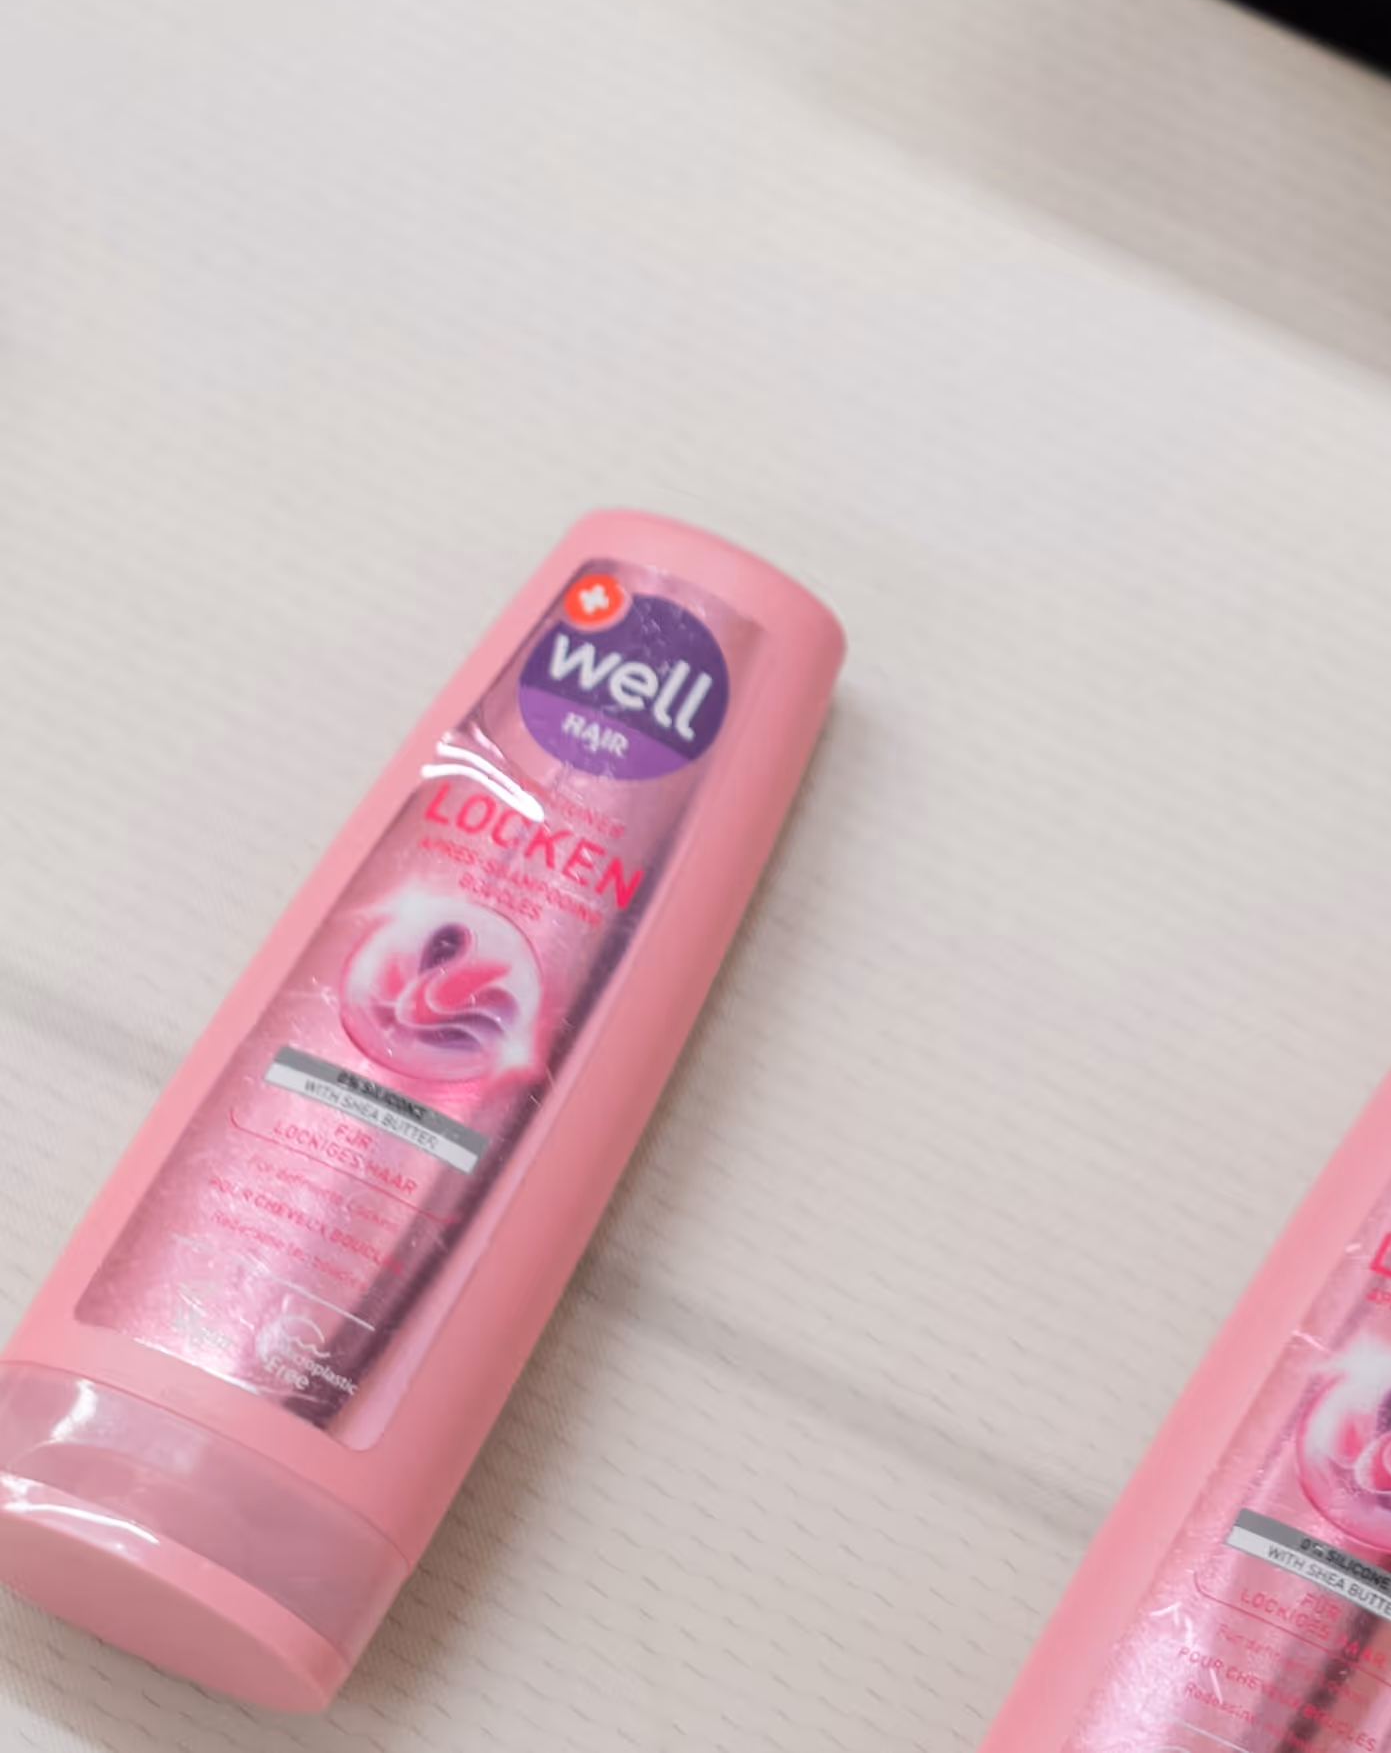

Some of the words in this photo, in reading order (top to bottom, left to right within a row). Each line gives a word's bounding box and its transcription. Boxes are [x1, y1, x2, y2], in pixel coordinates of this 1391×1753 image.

[549, 632, 713, 742] well
[561, 711, 630, 759] HAIR
[424, 780, 644, 910] LOCKEN
[304, 1078, 340, 1107] WITH
[340, 1096, 378, 1123] SHEA
[380, 1113, 439, 1151] BUTTER
[273, 1121, 364, 1169] LOCKIGES
[365, 1161, 419, 1196] HAAR
[263, 1352, 311, 1391] Free
[1266, 1545, 1308, 1573] WITH
[1306, 1562, 1346, 1591] SHEA
[1239, 1588, 1331, 1642] LOCKIGES
[1177, 1645, 1224, 1672] POUR
